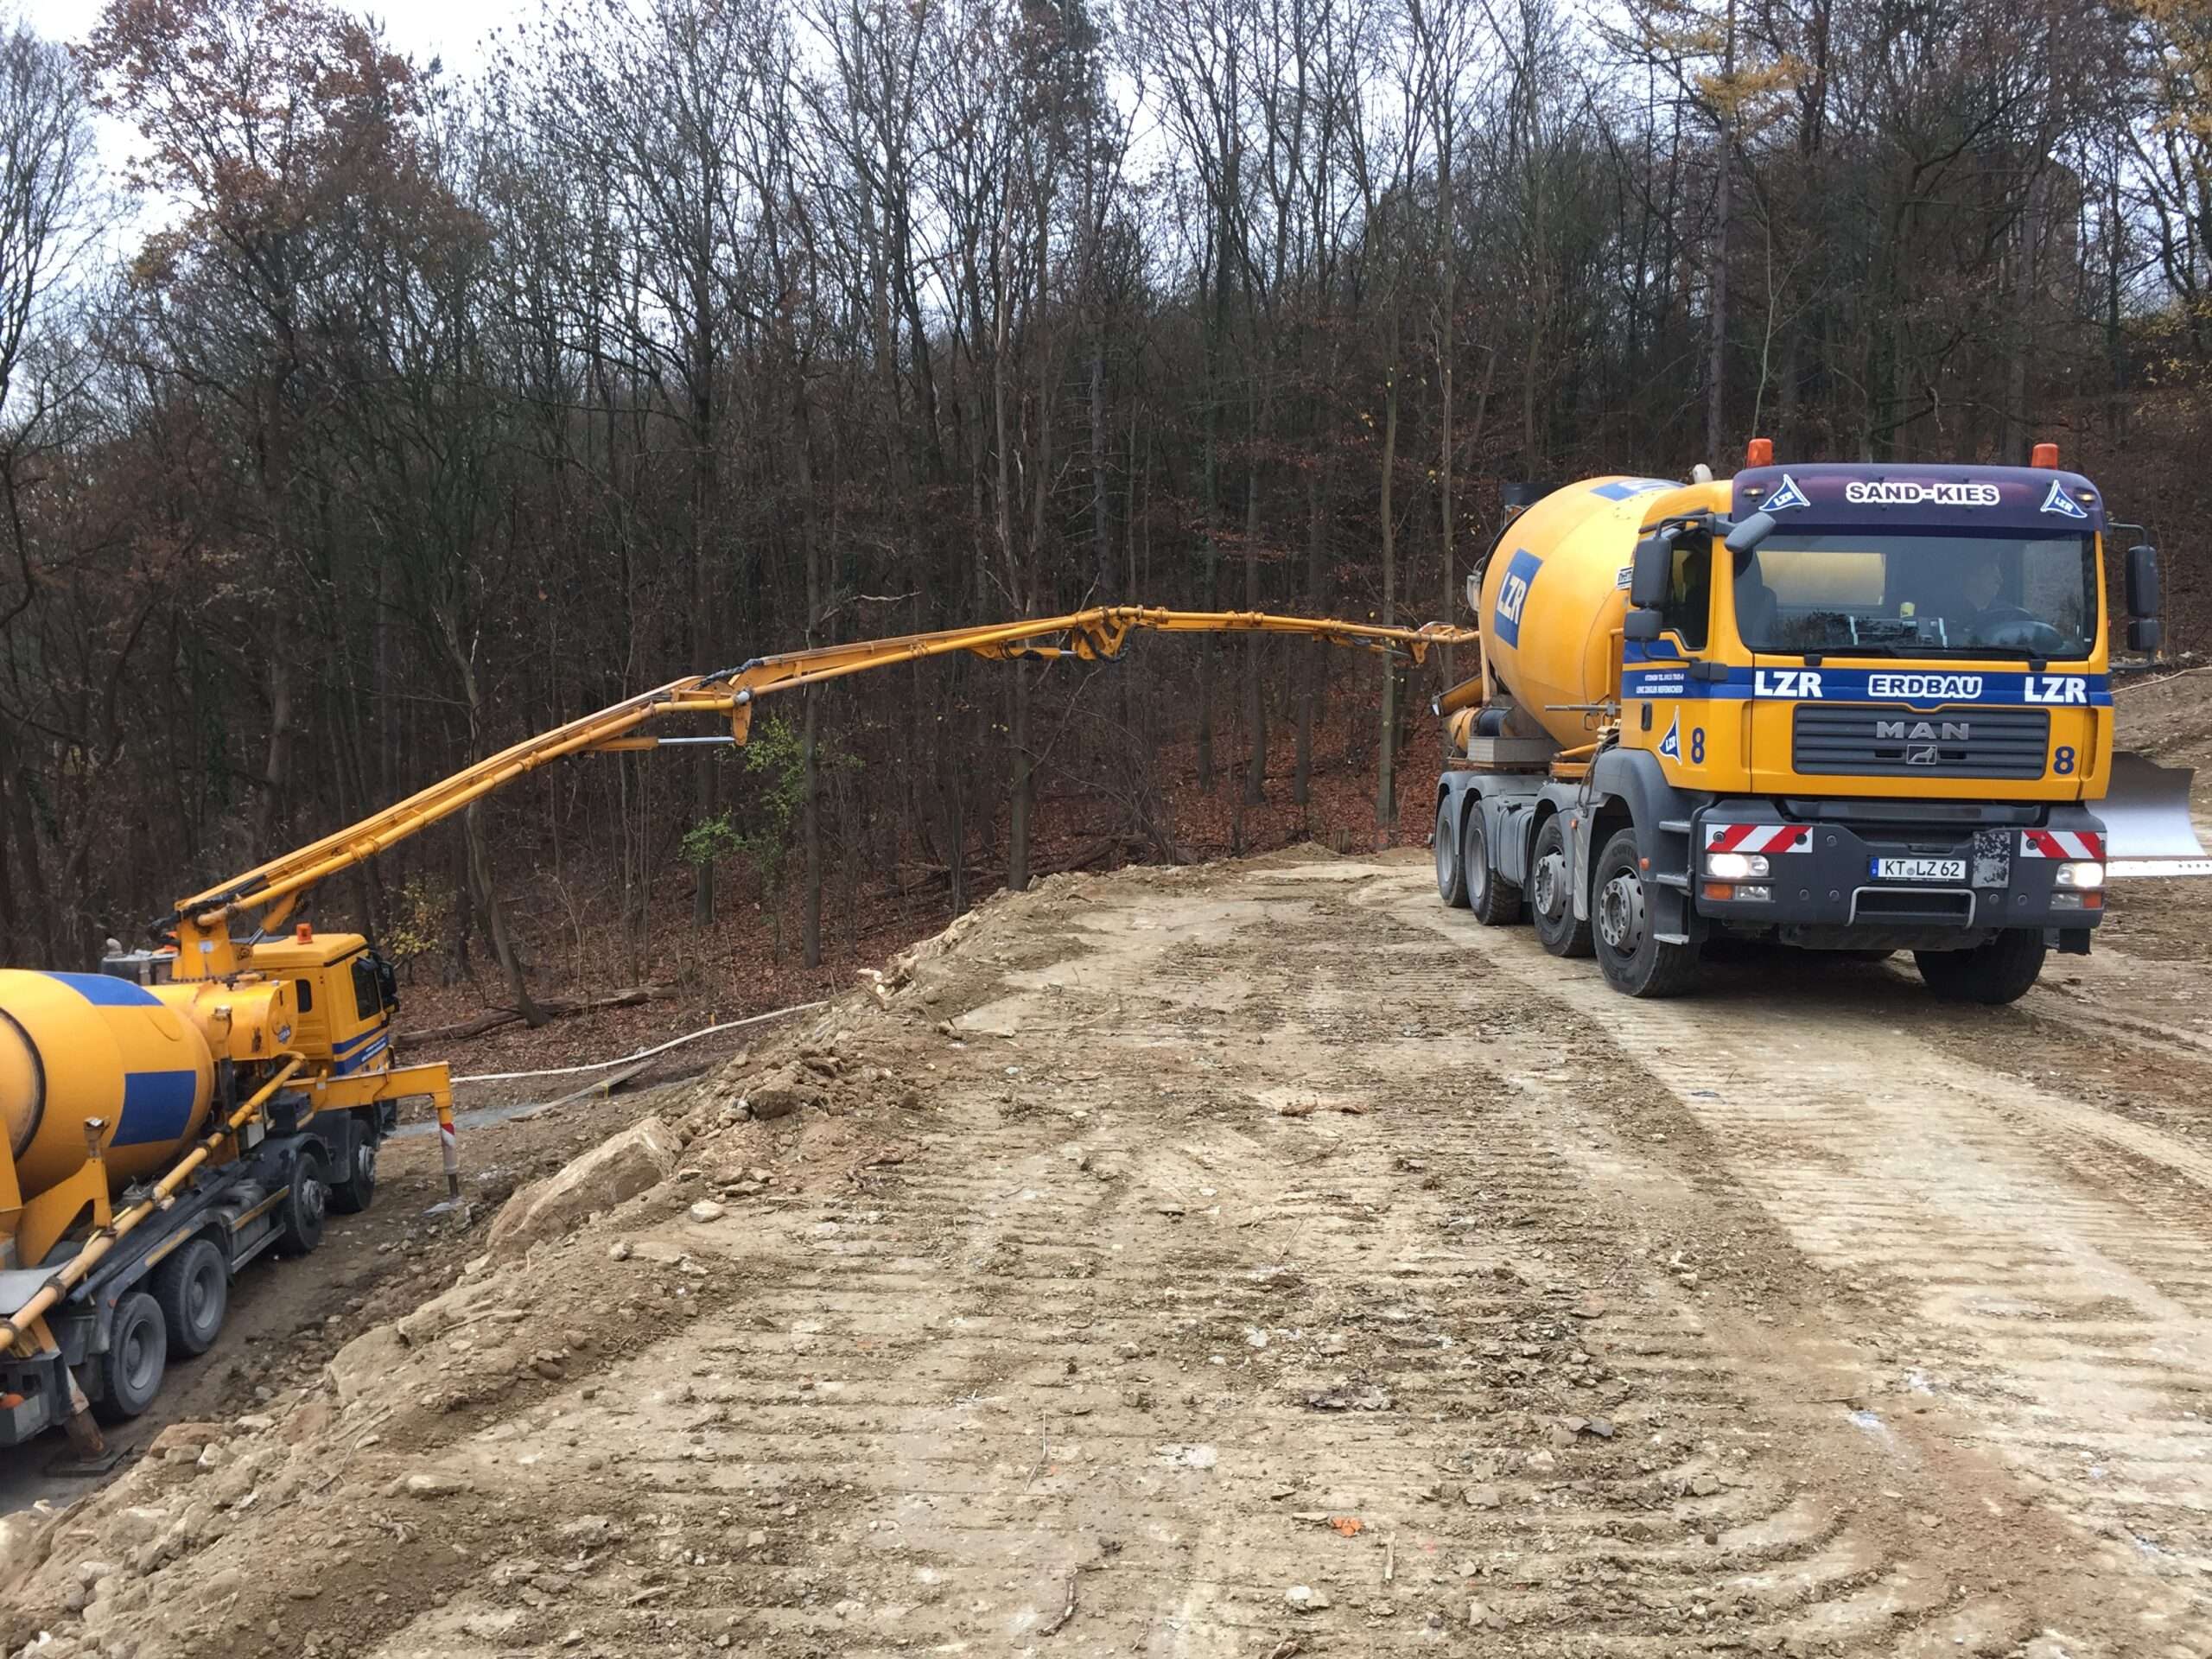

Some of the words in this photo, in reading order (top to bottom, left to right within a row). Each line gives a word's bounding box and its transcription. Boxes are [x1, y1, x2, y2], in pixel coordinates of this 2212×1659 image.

[1773, 492, 1795, 506] LZR
[1847, 484, 1999, 504] SAND-KIES
[2055, 496, 2073, 512] LZR
[1497, 572, 1527, 625] LZR
[1754, 671, 1823, 697] LZR
[1870, 675, 1981, 697] ERDBAU
[2024, 677, 2088, 703] LZR
[1875, 721, 1970, 741] MAN
[1665, 735, 1676, 753] LZR
[1691, 727, 1705, 765] 8
[2052, 746, 2075, 775] 8
[1885, 861, 1906, 875] KT
[1916, 861, 1937, 876] LZ
[1940, 861, 1960, 877] 62
